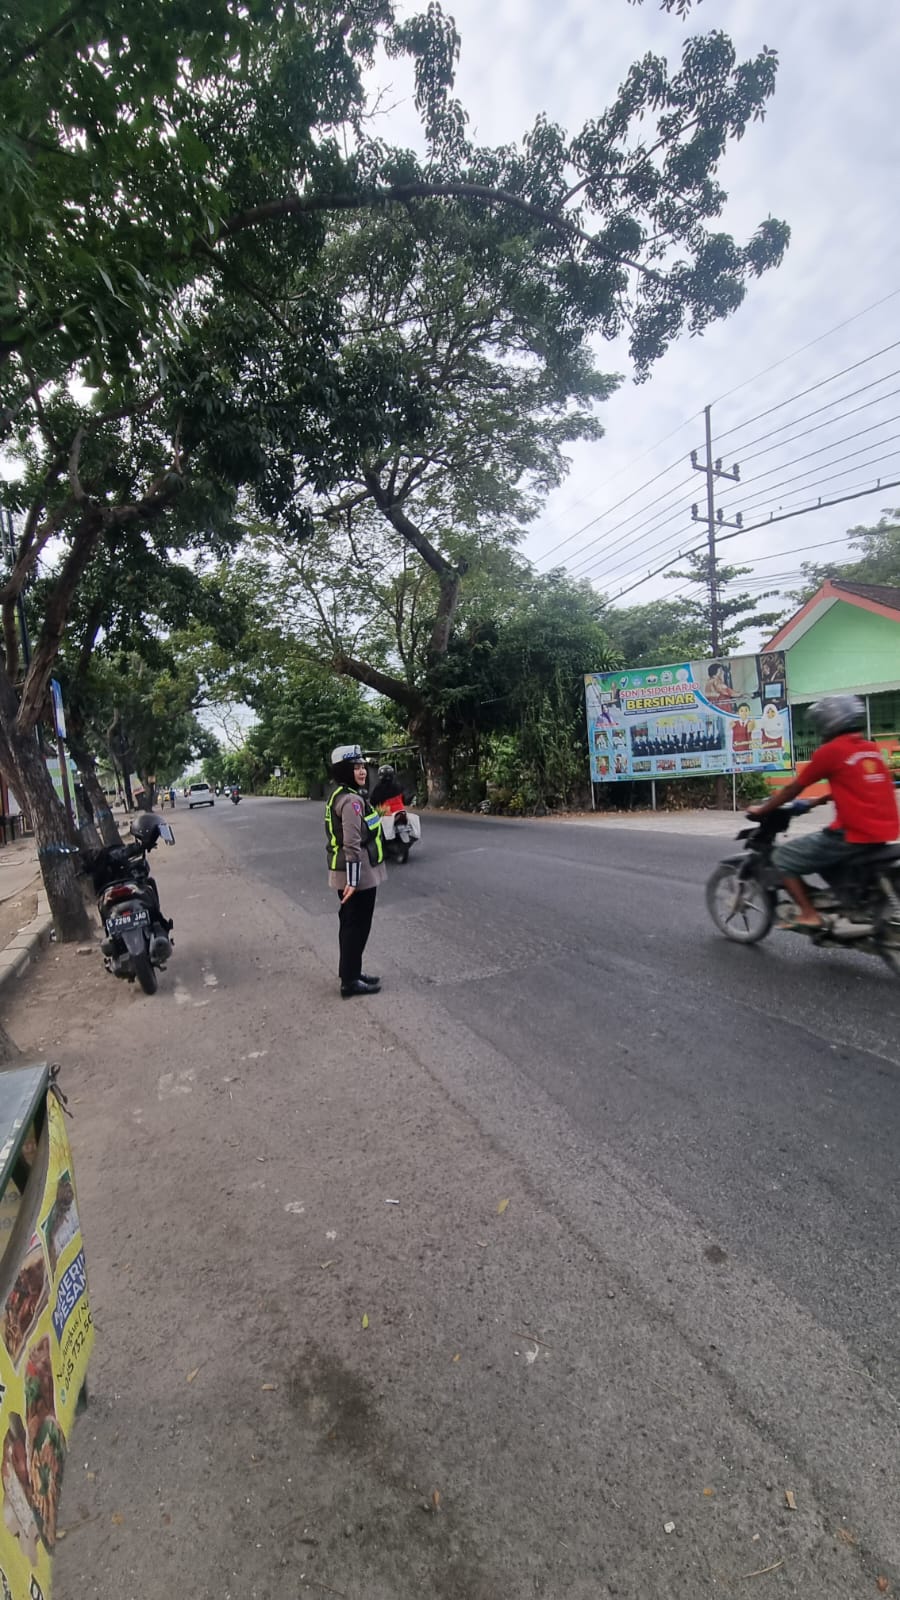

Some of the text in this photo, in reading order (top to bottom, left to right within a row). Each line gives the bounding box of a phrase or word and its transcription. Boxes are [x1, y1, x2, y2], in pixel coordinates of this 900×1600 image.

[620, 689, 638, 698] SDN
[646, 682, 700, 696] SIDOHARJO
[626, 693, 695, 710] BERSINAR
